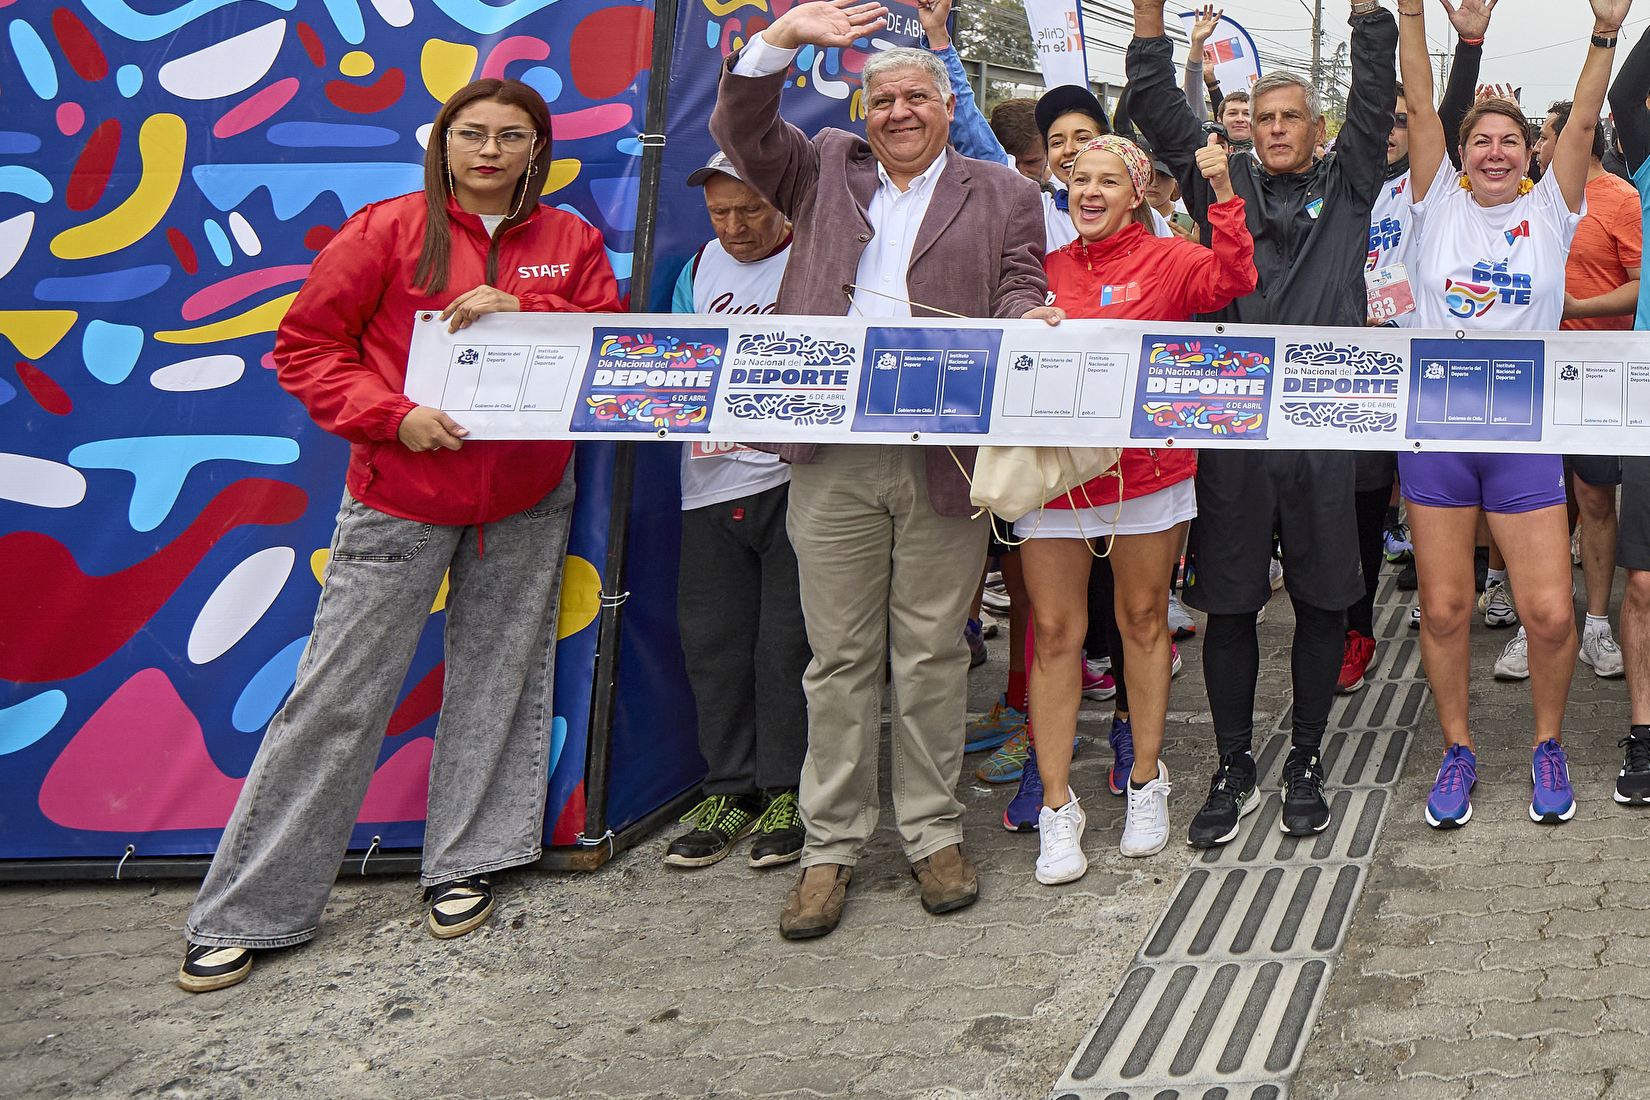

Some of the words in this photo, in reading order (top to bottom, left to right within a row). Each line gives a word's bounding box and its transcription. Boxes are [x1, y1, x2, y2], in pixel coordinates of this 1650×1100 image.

[887, 12, 902, 34] DE
[518, 263, 570, 279] STAFF
[1472, 269, 1532, 288] POR
[1499, 288, 1531, 305] TE
[598, 360, 612, 368] Día
[615, 360, 653, 368] Nacional
[1149, 367, 1162, 375] Día
[1165, 367, 1203, 376] Nacional
[1205, 368, 1218, 376] del
[1285, 367, 1298, 375] Día
[1301, 367, 1337, 375] Nacional
[1340, 367, 1351, 375] del
[592, 370, 713, 387] DEPORTE
[729, 369, 849, 385] DEPORTE
[1146, 377, 1265, 395] DEPORTE
[1283, 378, 1398, 393] DEPORTE
